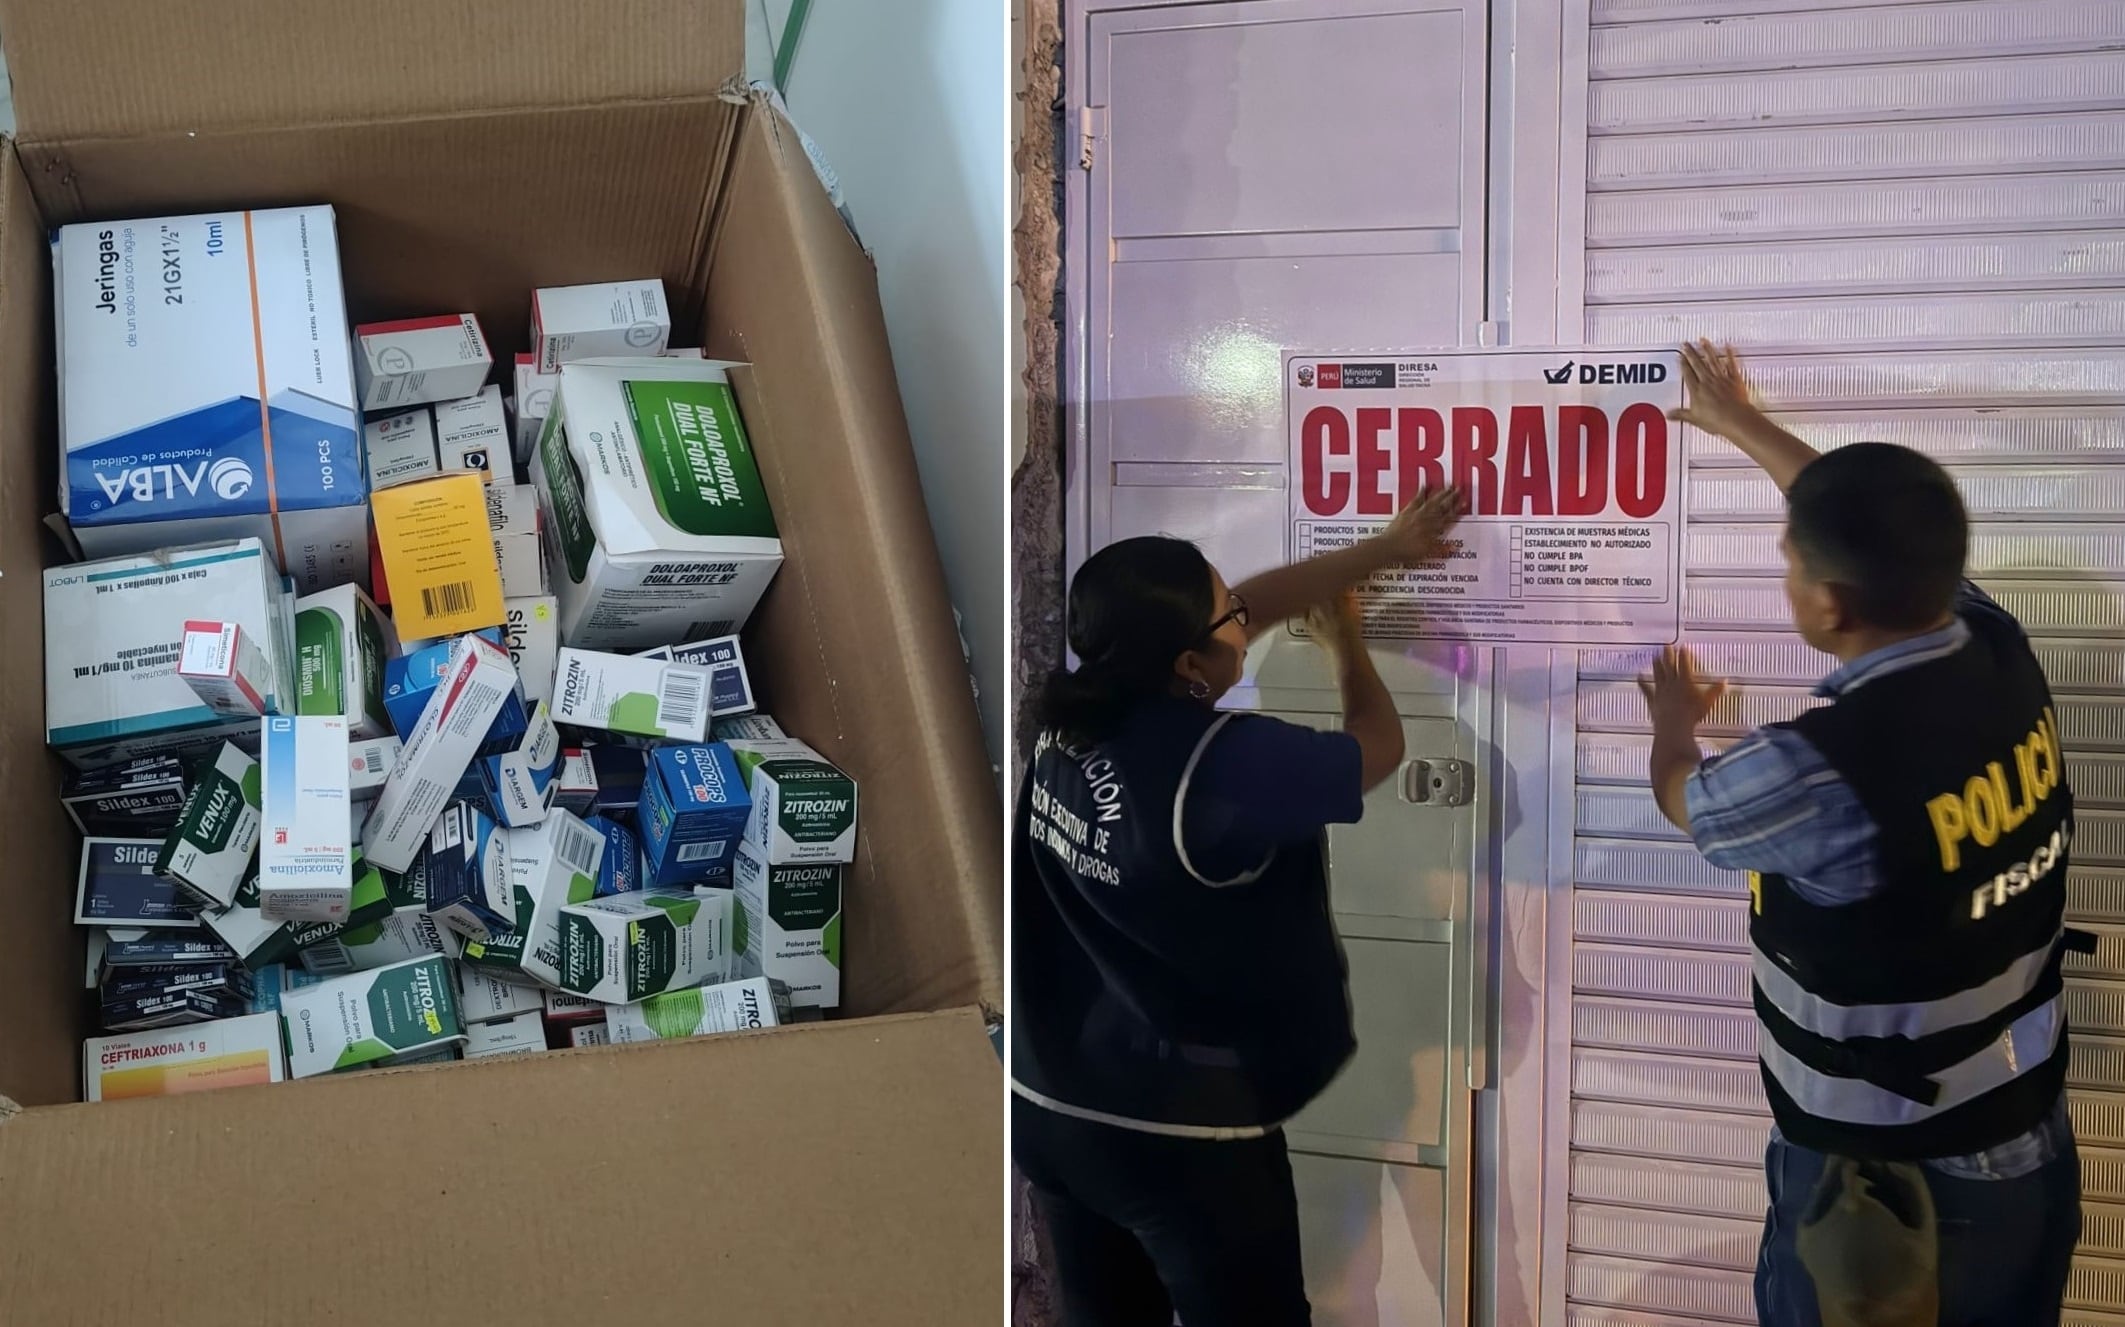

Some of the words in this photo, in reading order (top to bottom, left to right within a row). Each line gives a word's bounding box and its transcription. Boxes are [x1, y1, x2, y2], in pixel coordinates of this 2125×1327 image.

[121, 228, 136, 252] aguja
[205, 220, 224, 256] 10ml
[94, 230, 120, 314] Jeringas
[124, 254, 134, 274] con
[304, 258, 312, 276] LIBRE
[126, 276, 134, 294] uso
[124, 296, 136, 316] solo
[127, 318, 136, 332] un
[124, 334, 136, 348] de
[464, 318, 484, 357] Cetirizina
[546, 337, 558, 369] Cetirizina
[1344, 368, 1382, 376] Ministerio
[1398, 363, 1438, 372] DIRESA
[1579, 362, 1667, 385] DEMID
[1344, 377, 1354, 385] de
[1356, 376, 1376, 385] Salud
[672, 402, 700, 436] DUAL
[444, 426, 500, 442] AMOXICILINA
[142, 453, 156, 463] de
[159, 448, 212, 461] Productos
[318, 440, 332, 465] PCS
[695, 404, 742, 500] DOLOAPROXOL
[1301, 402, 1668, 518] CERRADO
[92, 455, 138, 469] Calidad
[376, 458, 429, 478] AMOXICILINA
[684, 439, 715, 484] FORTE
[94, 460, 209, 504] ALBA
[322, 470, 335, 491] 100
[698, 486, 722, 507] NF
[1314, 526, 1354, 534] PRODUCTOS
[1357, 526, 1368, 534] SIN
[1525, 528, 1565, 536] EXISTENCIA
[1566, 528, 1576, 536] DE
[1578, 528, 1616, 536] MUESTRAS
[1618, 526, 1650, 537] MÉDICAS
[1314, 538, 1354, 546] PRODUCTOS
[1524, 540, 1587, 548] ESTABLECIMIENTO
[1590, 540, 1602, 548] NO
[1604, 540, 1651, 548] AUTORIZADO
[1524, 552, 1535, 560] NO
[1538, 552, 1566, 560] CUMPLE
[1570, 552, 1583, 560] BPA
[192, 569, 208, 578] Caja
[650, 563, 739, 574] DOLOAPROXOL
[1402, 562, 1446, 570] ADULTERADO
[1524, 564, 1535, 572] NO
[1538, 564, 1566, 572] CUMPLE
[1570, 564, 1589, 572] BPOF
[123, 576, 164, 590] Ampollas
[165, 572, 180, 584] 100
[642, 574, 674, 584] DUAL
[677, 574, 717, 583] FORTE
[718, 573, 738, 582] NF
[1373, 574, 1394, 582] FECHA
[1396, 574, 1405, 582] DE
[1408, 573, 1448, 582] EXPIRACIÓN
[1451, 574, 1478, 582] VENCIDA
[1524, 577, 1534, 585] NO
[1537, 577, 1564, 586] CUENTA
[1566, 578, 1582, 586] CON
[1584, 578, 1619, 586] DIRECTOR
[1622, 576, 1652, 586] TÉCNICO
[96, 586, 108, 594] mL
[1368, 586, 1415, 594] PROCEDENCIA
[1418, 586, 1465, 594] DESCONOCIDA
[117, 644, 169, 660] Inyectable
[218, 628, 231, 670] Simeticona
[313, 644, 322, 656] mg
[712, 648, 731, 662] 100
[74, 667, 90, 679] mL
[122, 661, 134, 672] 10
[312, 658, 322, 672] 500
[562, 658, 581, 716] ZITROZIN
[132, 773, 158, 782] Sildex
[691, 748, 727, 803] PROCOPS
[505, 768, 529, 810] DIARGEM
[693, 784, 709, 802] 100
[96, 795, 150, 812] Sildex
[153, 794, 176, 805] 100
[196, 782, 230, 840] VENUX
[220, 807, 231, 822] 100
[228, 795, 238, 809] mg
[784, 800, 847, 814] ZITROZIN
[1094, 827, 1111, 854] DE
[114, 846, 161, 864] Silde
[269, 865, 344, 875] Amoxicilina
[495, 838, 508, 906] DIARGEM
[774, 868, 832, 882] ZITROZIN
[1072, 848, 1078, 870] Y
[1078, 853, 1120, 886] DROGAS
[294, 922, 344, 945] VENUX
[419, 913, 446, 954] ZITROZIN
[184, 942, 211, 952] Sildex
[806, 940, 821, 948] para
[570, 921, 579, 987] ZITROZIN
[637, 928, 646, 992] ZITROZIN
[776, 950, 816, 959] Suspensión
[174, 974, 200, 984] Sildex
[202, 972, 212, 980] 100
[410, 982, 418, 994] 200
[136, 997, 161, 1010] Sildex
[162, 994, 174, 1002] 100
[350, 998, 358, 1022] Polvo
[742, 988, 762, 1028] ZITRO
[338, 990, 350, 1037] Suspensión
[304, 1020, 315, 1054] MARKOS
[353, 1022, 362, 1040] para
[101, 1043, 185, 1064] CEFTRIAXONA
[189, 1040, 194, 1051] 1
[198, 1042, 206, 1052] g
